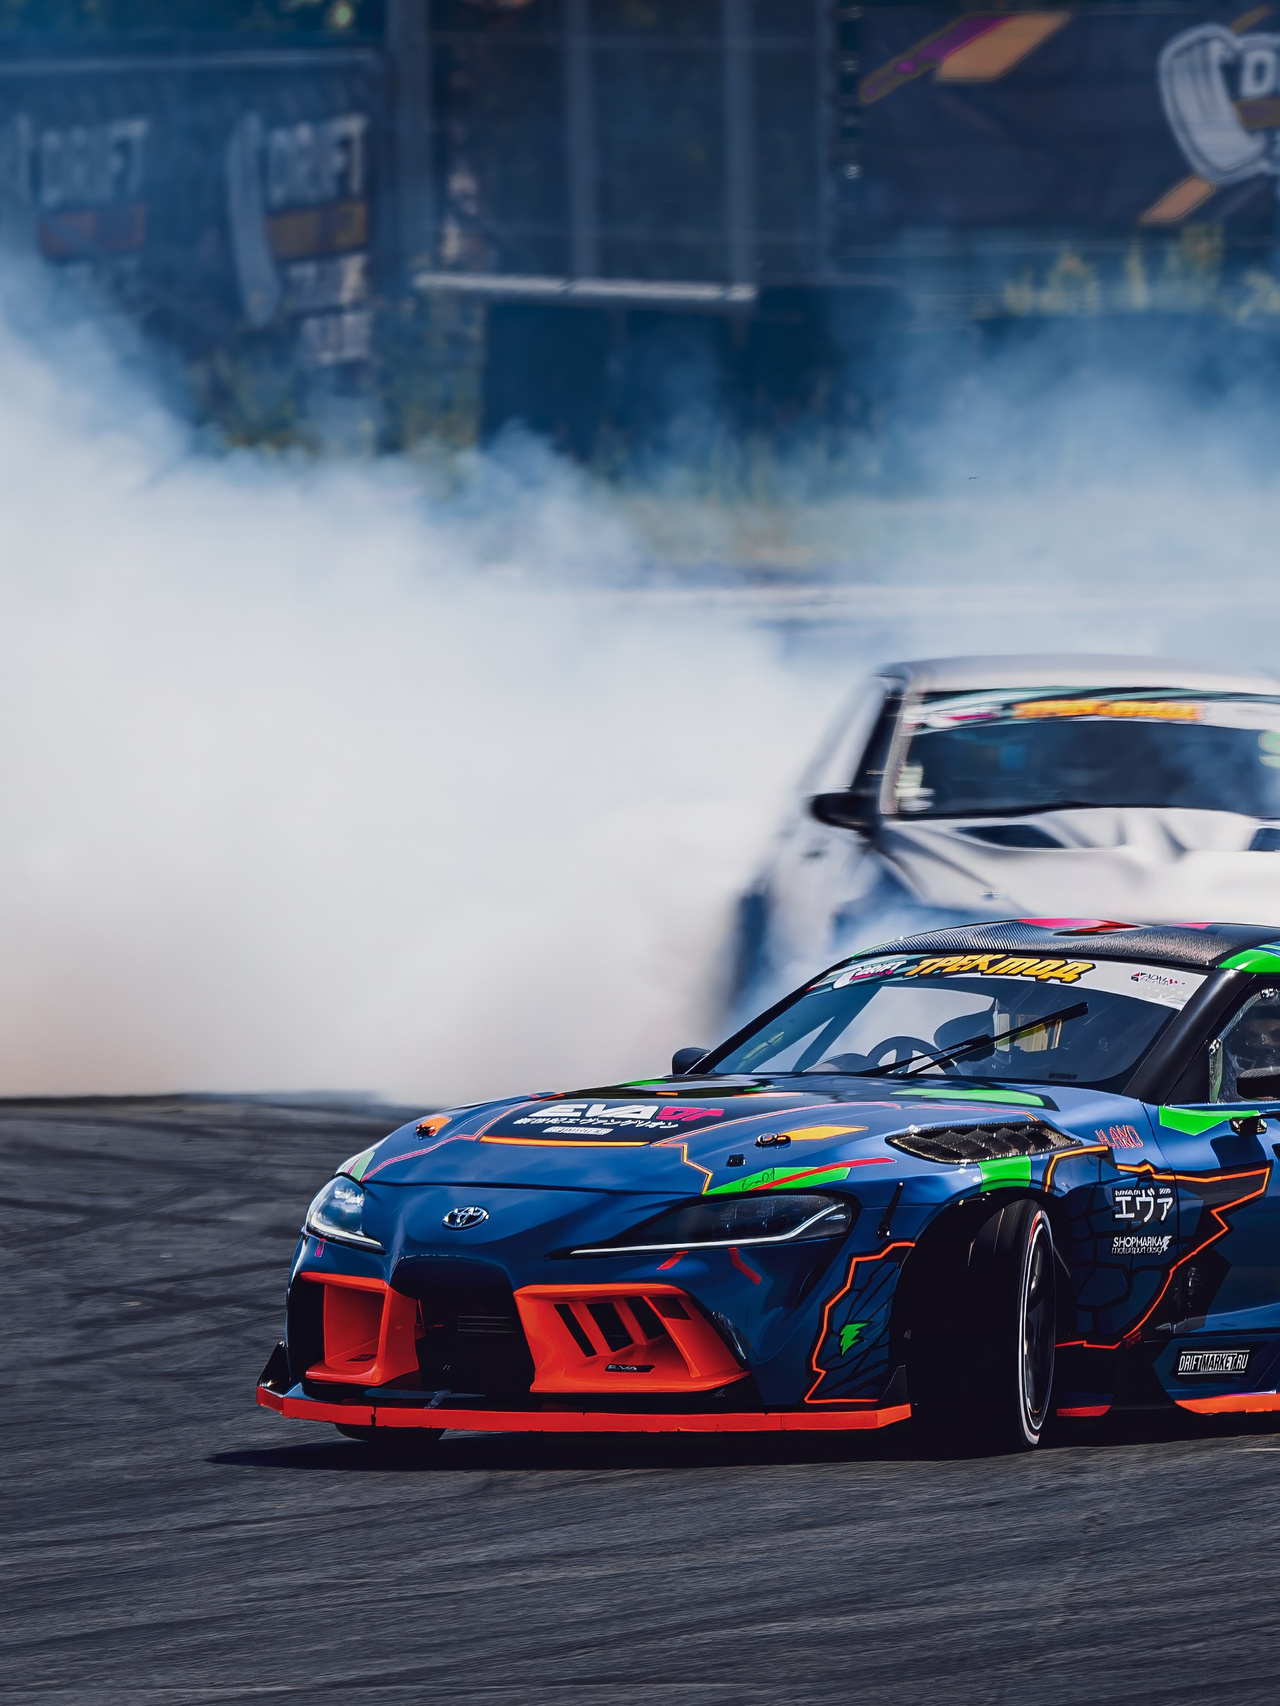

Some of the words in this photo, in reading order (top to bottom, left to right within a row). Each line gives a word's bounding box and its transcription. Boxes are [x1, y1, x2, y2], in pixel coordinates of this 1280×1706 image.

[1114, 1187, 1173, 1223] エヴァ
[1178, 1353, 1249, 1372] DRIFTMARKET.RU
